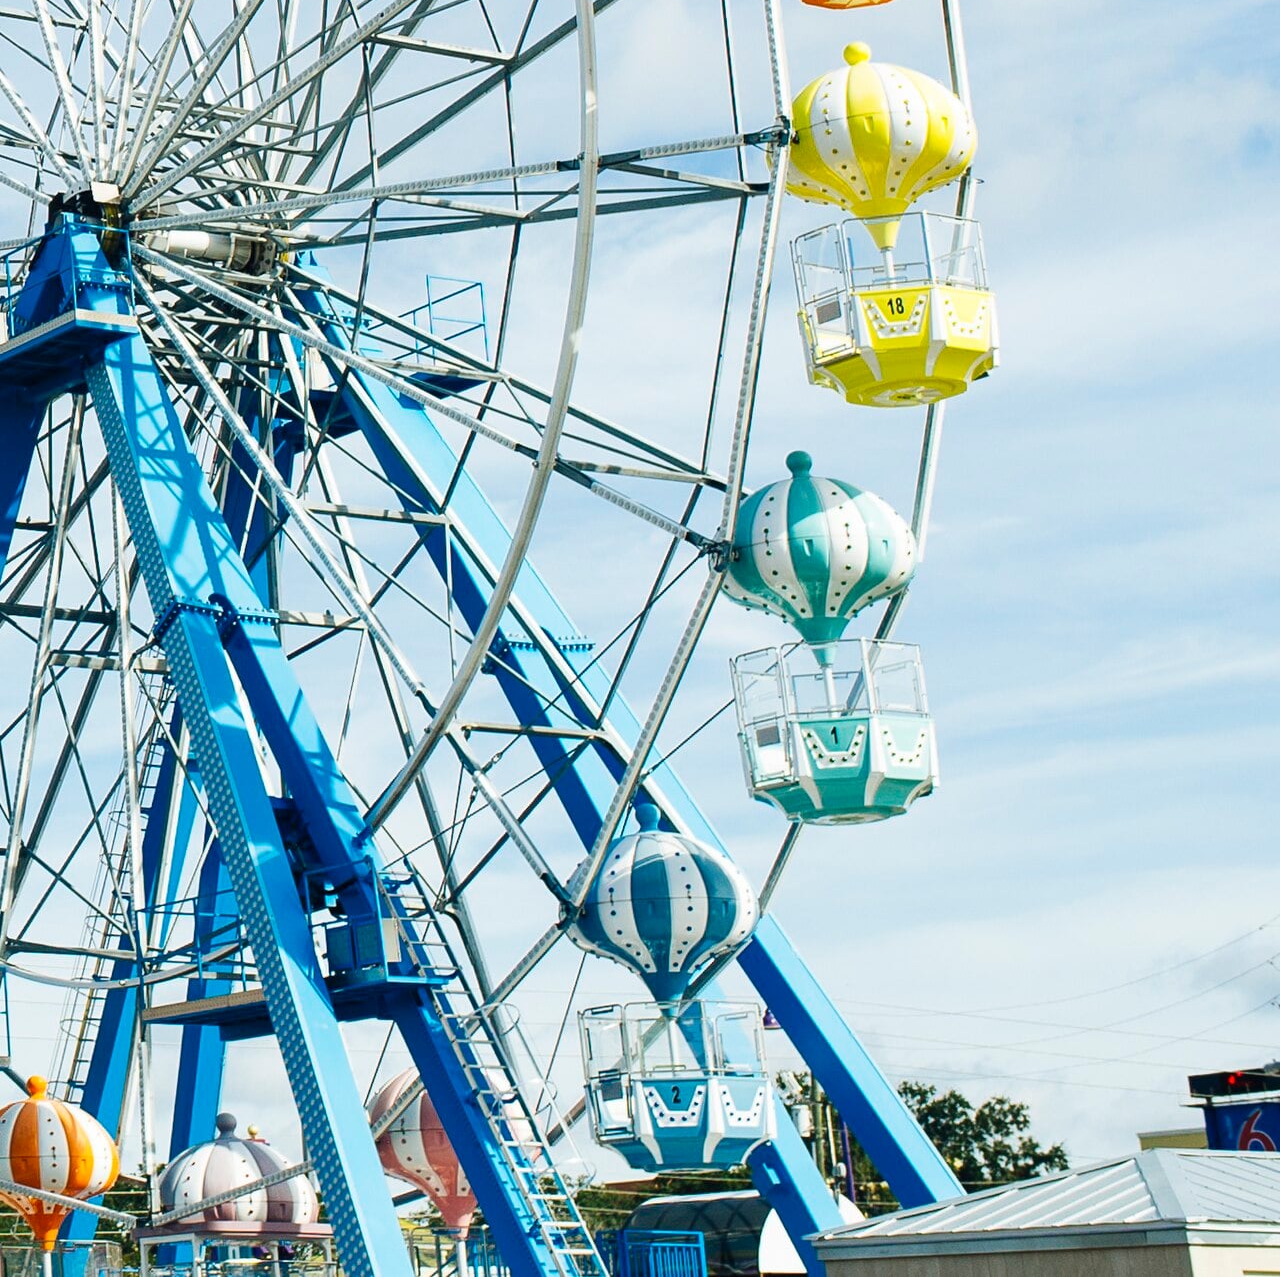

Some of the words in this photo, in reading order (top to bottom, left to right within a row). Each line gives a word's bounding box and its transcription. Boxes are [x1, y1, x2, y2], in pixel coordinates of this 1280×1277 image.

[887, 297, 904, 315] 18
[831, 726, 838, 744] 1
[671, 1085, 681, 1103] 2
[1238, 1109, 1277, 1151] 6
